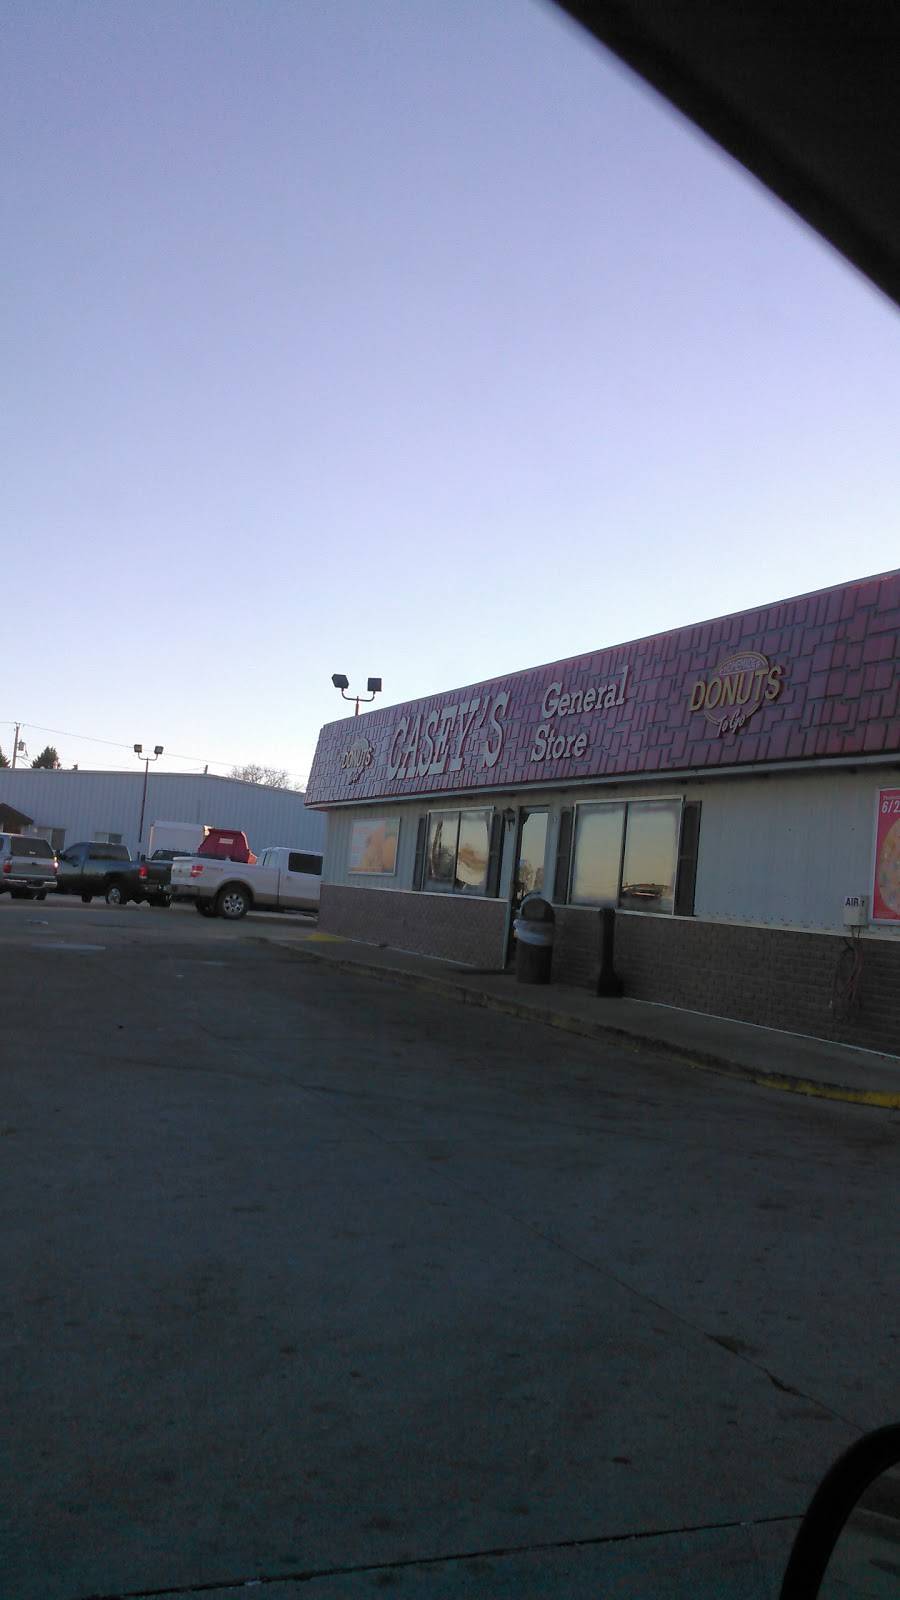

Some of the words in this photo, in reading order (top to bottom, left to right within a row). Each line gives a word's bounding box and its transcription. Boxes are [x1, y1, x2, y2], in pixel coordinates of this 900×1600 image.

[542, 666, 629, 719] General
[689, 665, 783, 712] DONUTS
[388, 691, 510, 780] CASEY'S
[530, 724, 588, 763] Store
[845, 897, 859, 907] AIR
